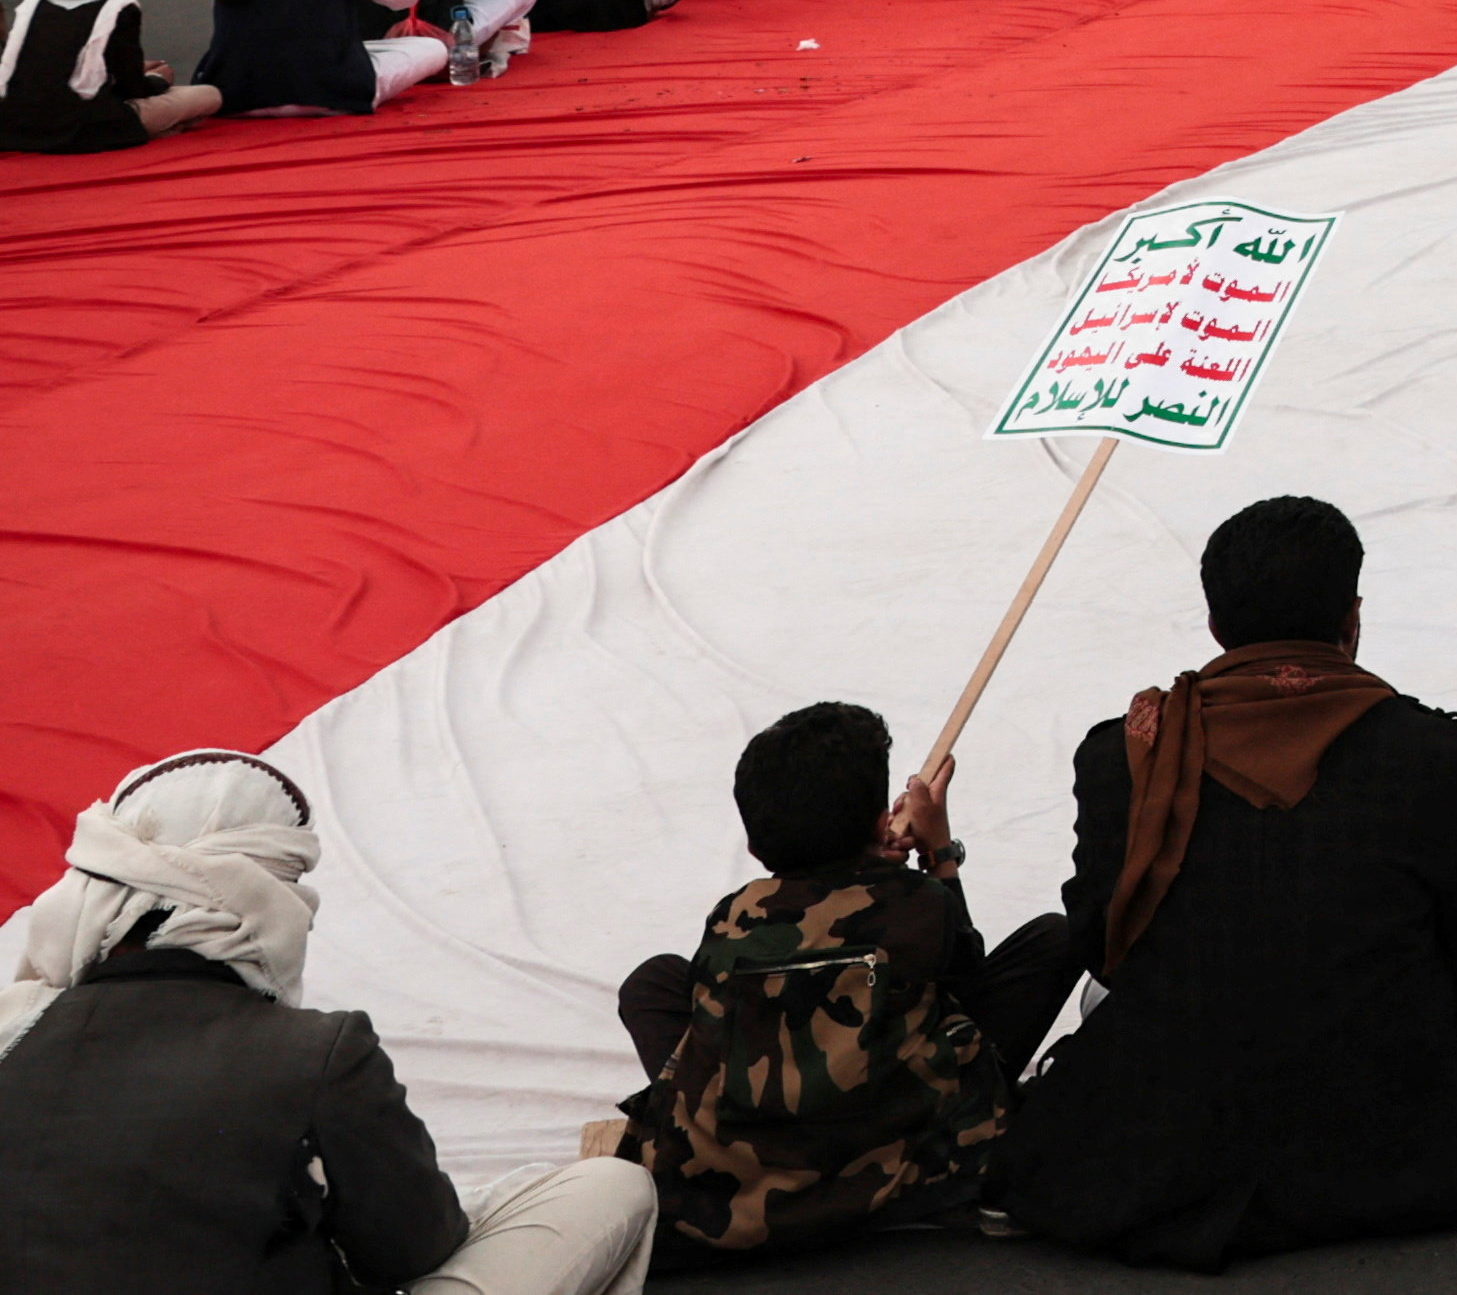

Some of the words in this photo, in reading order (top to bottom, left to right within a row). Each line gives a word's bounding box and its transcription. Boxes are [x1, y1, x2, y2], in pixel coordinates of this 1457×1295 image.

[1113, 208, 1243, 264] أكبر
[1233, 227, 1316, 265] الله
[1095, 257, 1200, 293] لأمريكا
[1202, 272, 1293, 302] الموت
[1069, 301, 1181, 336] لإسرائيل
[1180, 310, 1272, 341] الموت
[1046, 341, 1125, 374] اليهود
[1124, 341, 1172, 370] على
[1180, 348, 1252, 382] اللعنة
[1014, 376, 1130, 422] للإسلام
[1123, 390, 1232, 427] النصر
